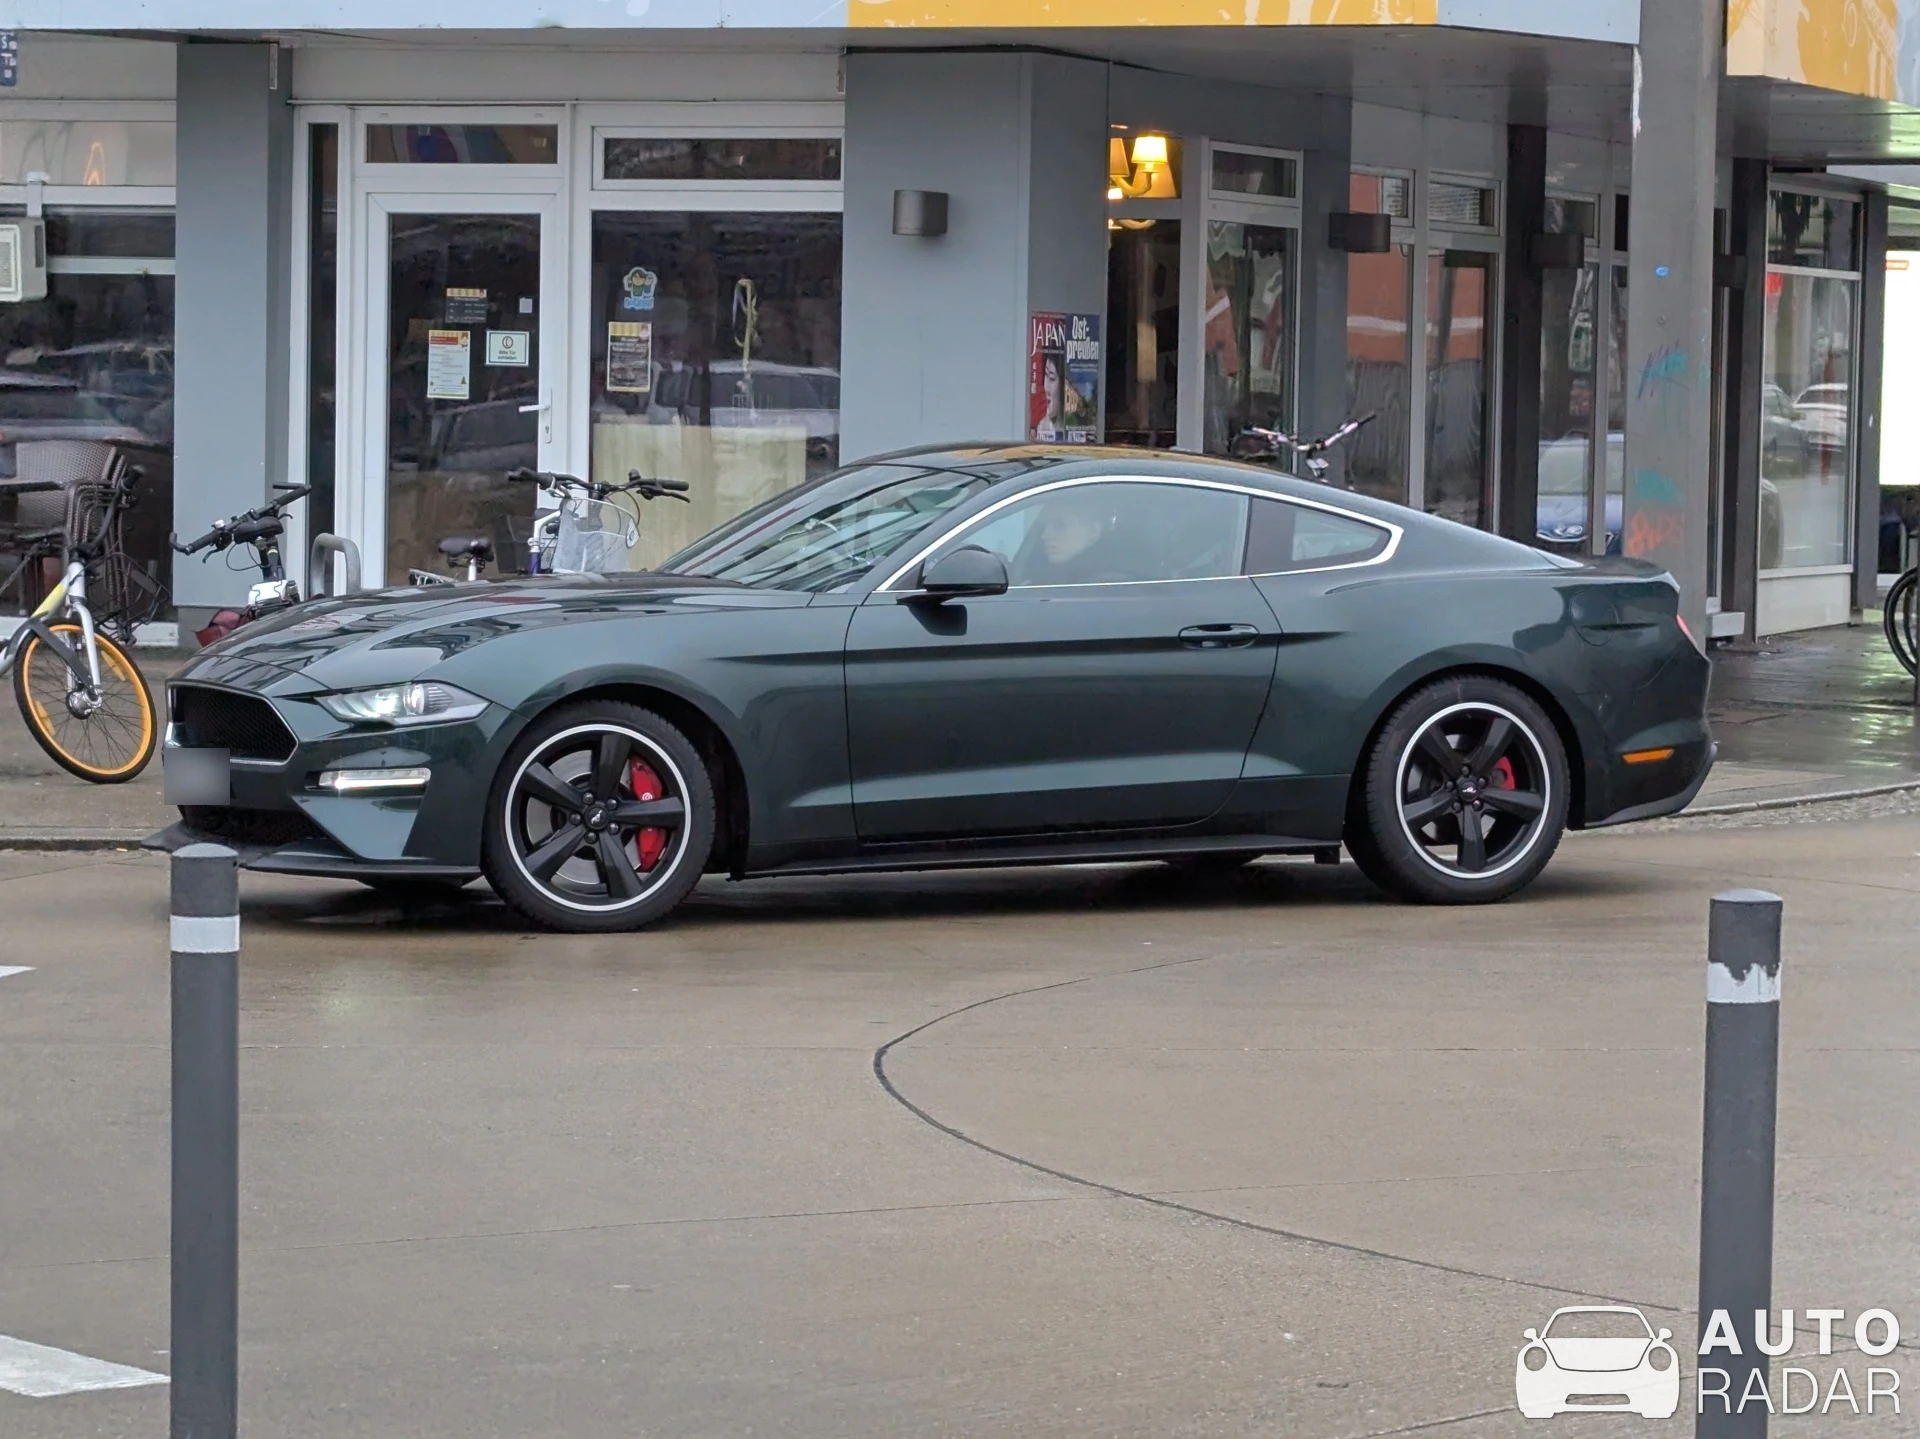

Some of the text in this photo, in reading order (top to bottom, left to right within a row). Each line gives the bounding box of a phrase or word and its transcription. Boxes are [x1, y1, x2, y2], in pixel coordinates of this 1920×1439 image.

[1031, 318, 1066, 356] JAPAN
[1072, 315, 1090, 340] Ost-
[1066, 336, 1099, 363] preußen
